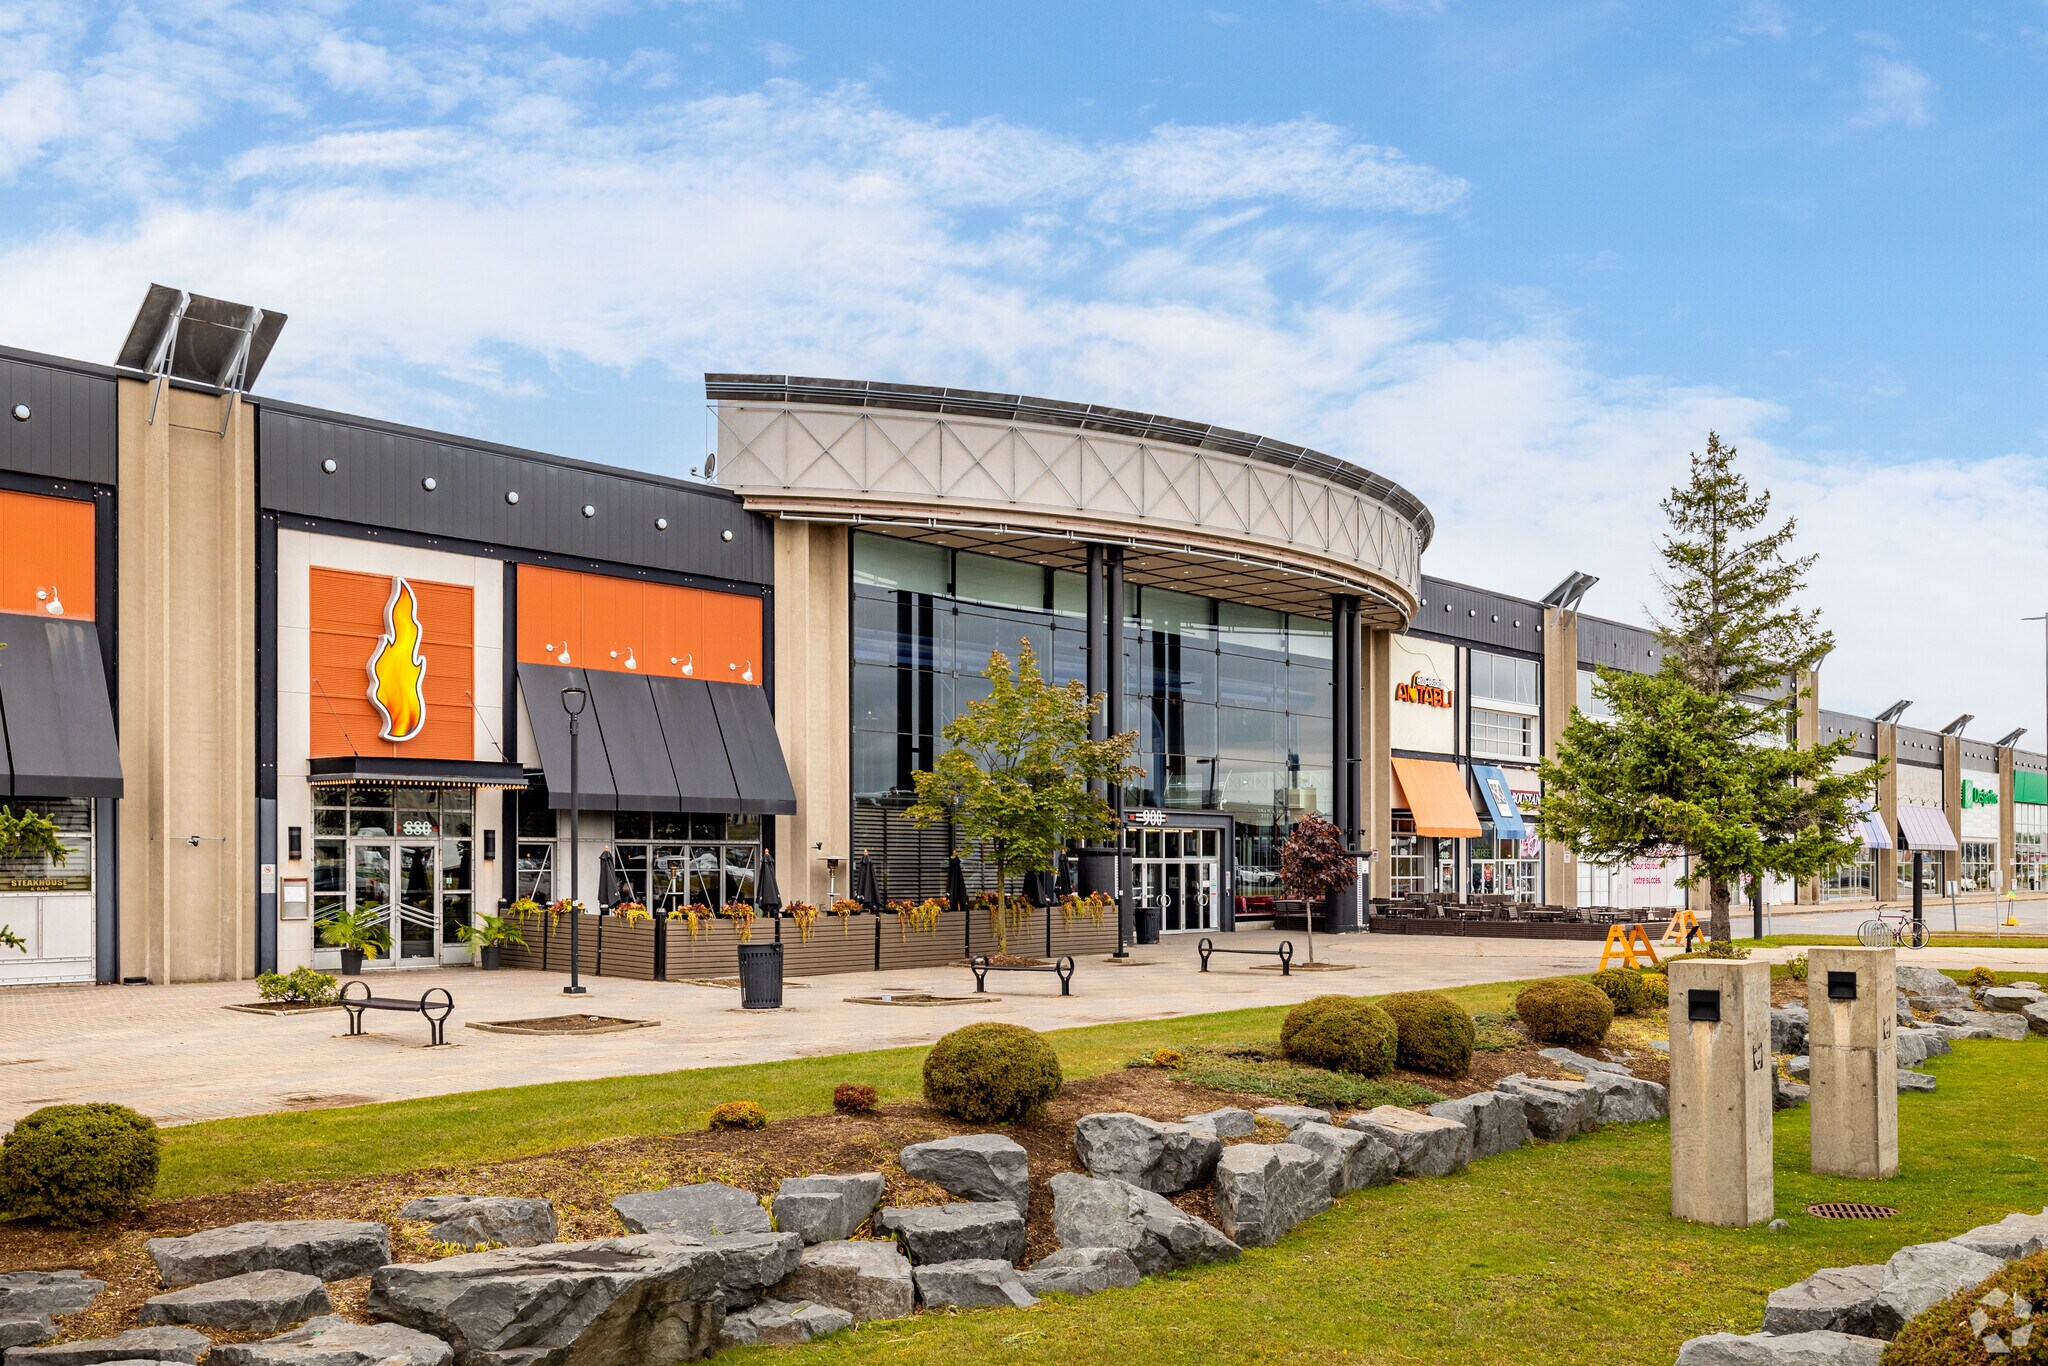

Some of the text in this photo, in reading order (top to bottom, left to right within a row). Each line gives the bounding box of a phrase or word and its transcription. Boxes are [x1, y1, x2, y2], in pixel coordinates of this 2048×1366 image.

[1395, 682, 1453, 708] ANTABLI
[1142, 810, 1162, 825] 900
[11, 879, 67, 887] STEAKHOUSE
[1633, 876, 1645, 884] votre
